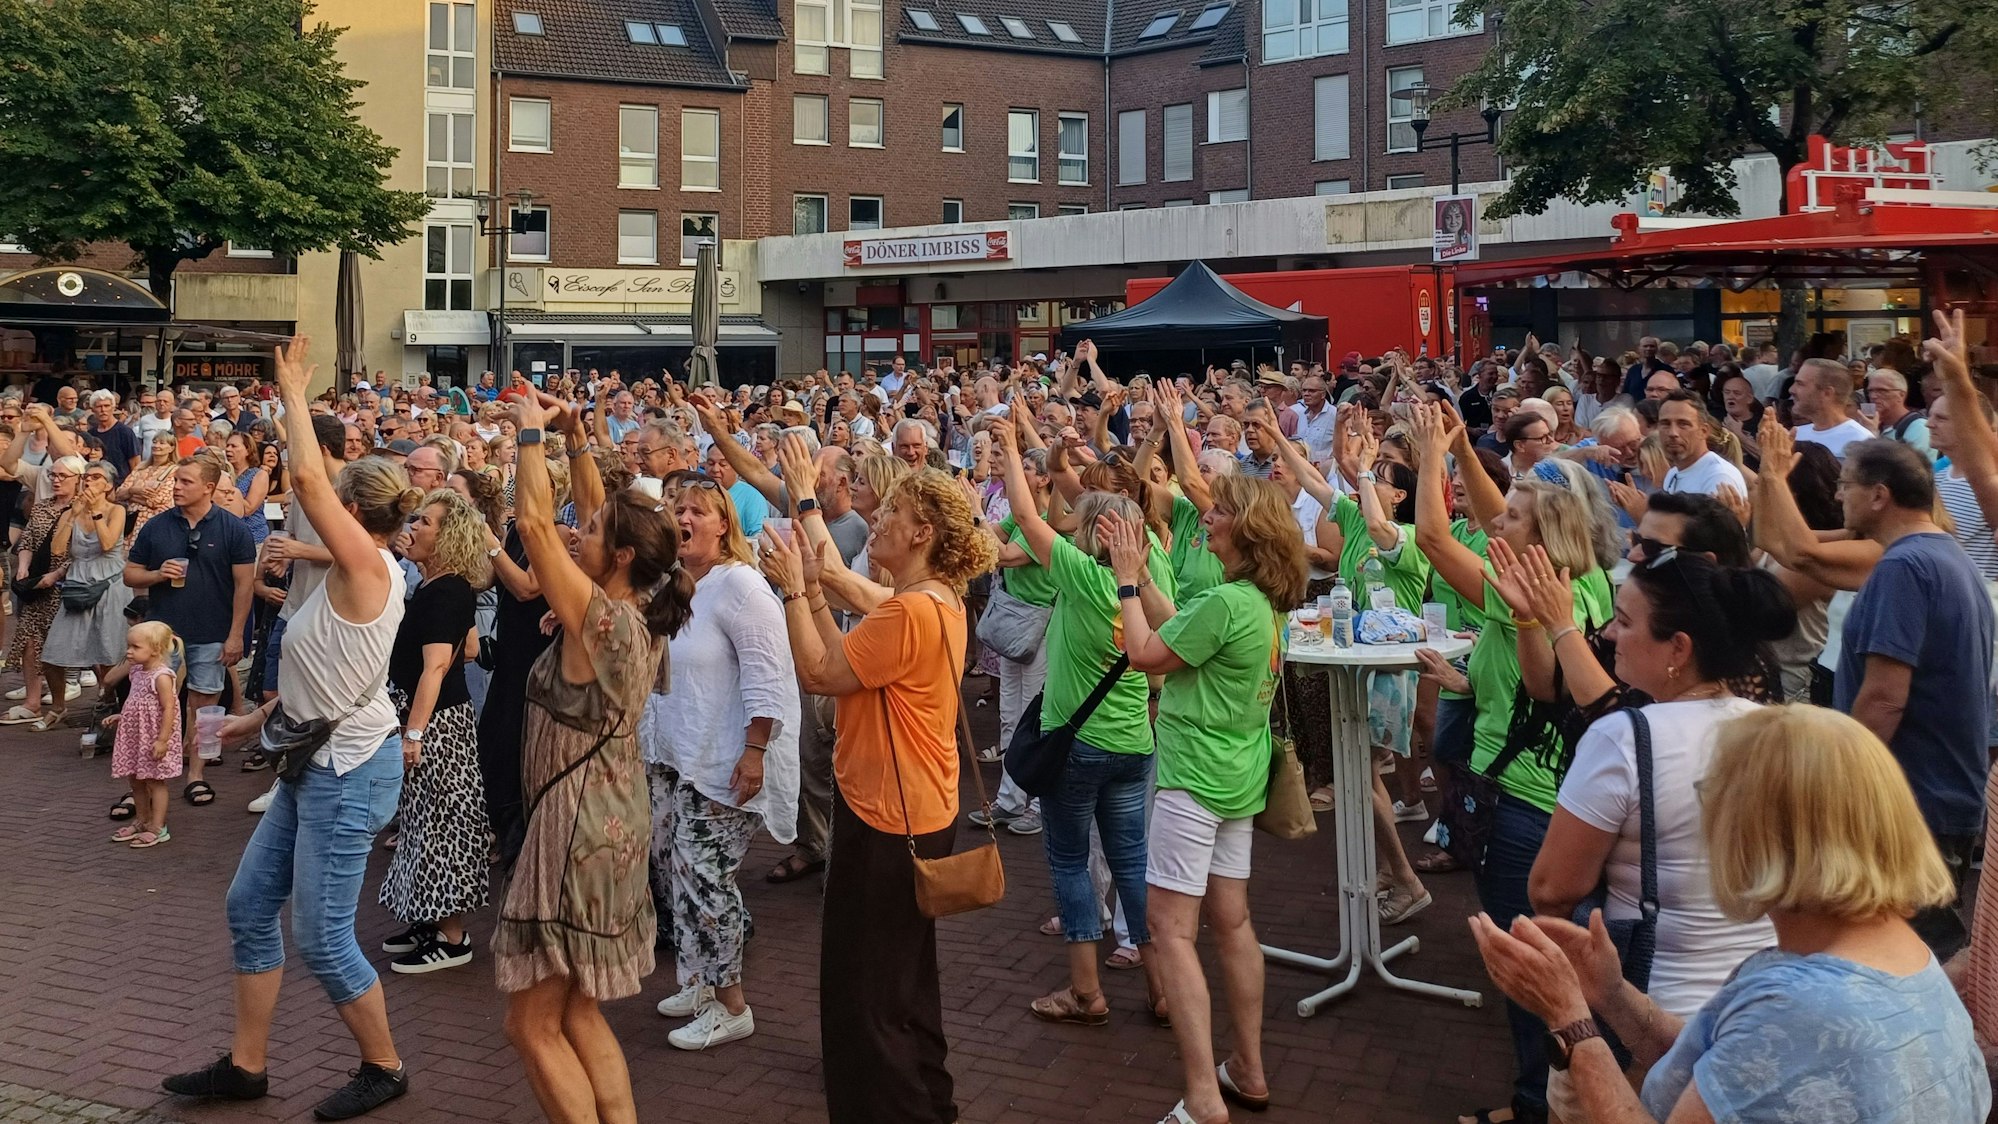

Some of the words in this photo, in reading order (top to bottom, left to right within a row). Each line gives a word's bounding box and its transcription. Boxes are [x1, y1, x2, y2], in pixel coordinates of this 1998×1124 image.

[1651, 183, 1661, 202] dm
[867, 242, 918, 259] DÖNER
[922, 239, 980, 256] IMBISS
[1442, 249, 1451, 257] Die
[1451, 246, 1466, 255] Linke
[563, 275, 625, 297] Eiscafe
[627, 277, 663, 293] San
[410, 333, 417, 343] 9
[176, 364, 198, 376] DIE
[214, 361, 260, 376] MÖHRE
